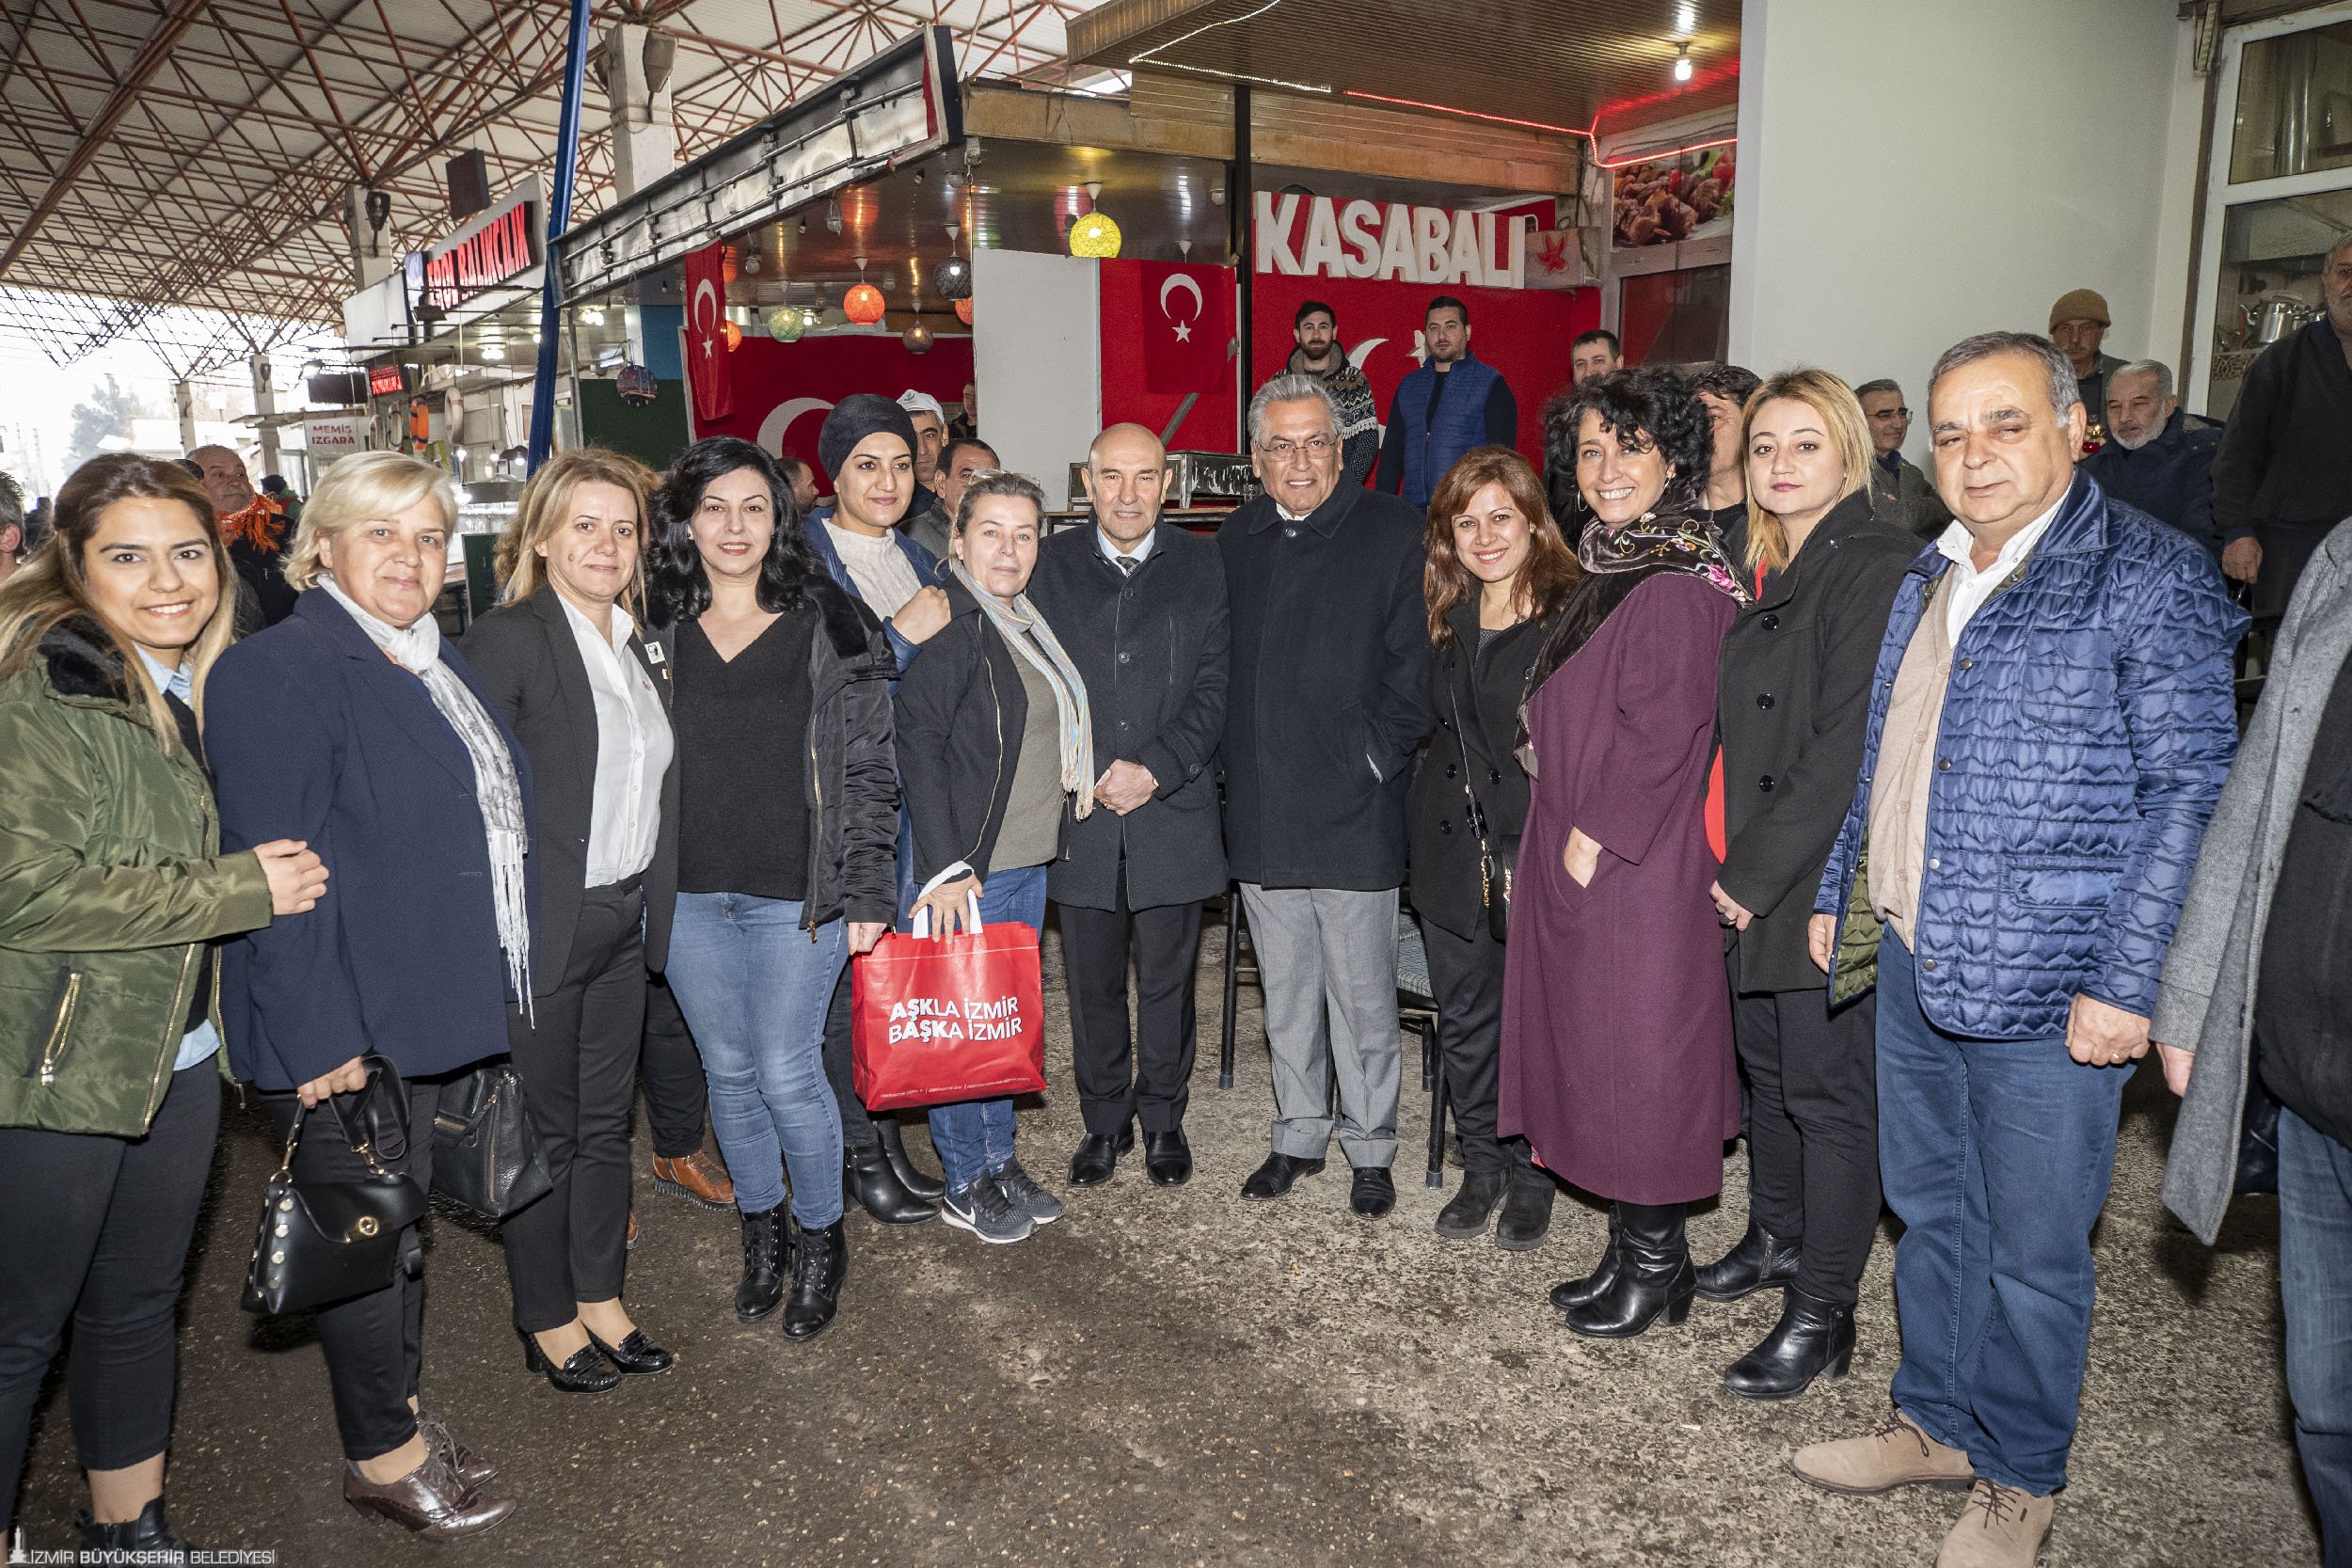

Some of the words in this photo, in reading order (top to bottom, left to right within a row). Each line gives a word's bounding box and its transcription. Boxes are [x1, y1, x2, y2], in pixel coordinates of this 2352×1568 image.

[1254, 190, 1526, 290] KASABALI
[311, 436, 356, 445] IZGARA
[888, 998, 961, 1023] AŞKLA
[963, 995, 1019, 1020] İZMİR
[888, 1019, 964, 1045] BAŞKA
[967, 1016, 1023, 1041] İZMİR
